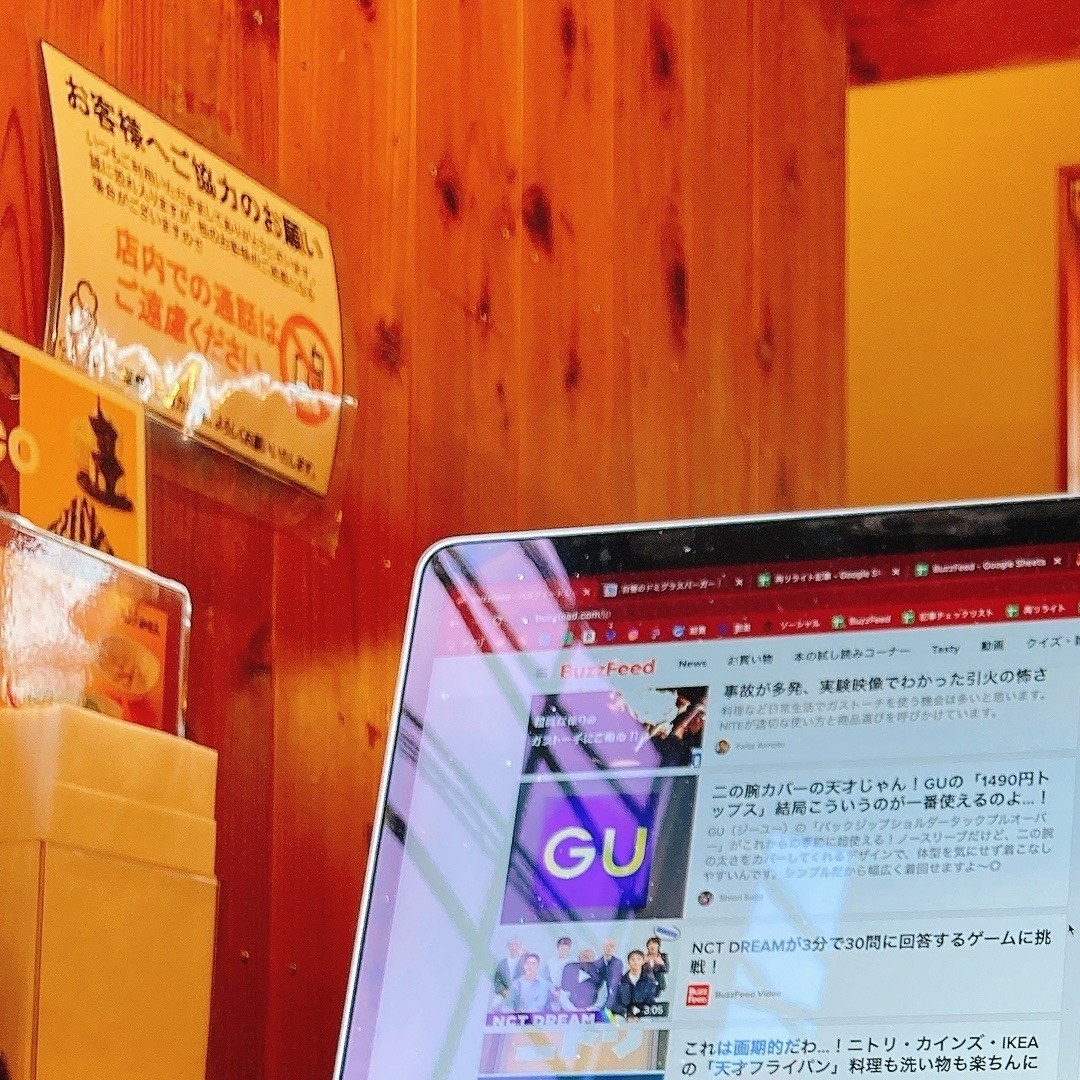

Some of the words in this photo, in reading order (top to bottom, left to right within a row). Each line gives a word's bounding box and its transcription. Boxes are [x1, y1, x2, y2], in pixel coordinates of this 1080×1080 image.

[66, 76, 325, 259] お客様へご協力のお願い
[115, 229, 281, 348] 店内での通話は
[115, 276, 263, 373] ご遠慮ください
[839, 569, 871, 580] Google
[932, 563, 976, 574] BuzzFeed
[982, 560, 1014, 571] Google
[1015, 558, 1047, 568] Sheets
[848, 614, 892, 626] BuzzFeed
[794, 647, 912, 662] 本の試し読みコーナー
[981, 640, 1005, 651] 動画
[560, 658, 656, 680] BuzzFeed
[678, 659, 708, 669] News
[727, 654, 775, 666] お買い物
[724, 667, 1048, 699] 事故が多発、実験映像でわかった引火の怖さ
[721, 690, 1046, 717] 料理など日常生活でガストーチを使う機会は多いと思います。
[719, 708, 998, 732] NITEが適切な使い方と商品選びを呼びかけています。
[712, 771, 1050, 800] 二の腕カバーの天才じゃん！GUの「1490円ト
[543, 825, 648, 879] GU
[692, 942, 725, 955] NCT
[729, 929, 1052, 954] DREAMが3分で30問に回答するゲームに挑
[690, 959, 717, 976] 戦！
[715, 990, 756, 999] BuzzFeed
[758, 989, 782, 998] Video
[492, 1014, 531, 1027] NCT
[533, 1011, 597, 1026] DREAM
[642, 1006, 664, 1016] 3:05
[682, 1055, 1039, 1077] の「天才フライパン」料理も洗い物も楽ちんに
